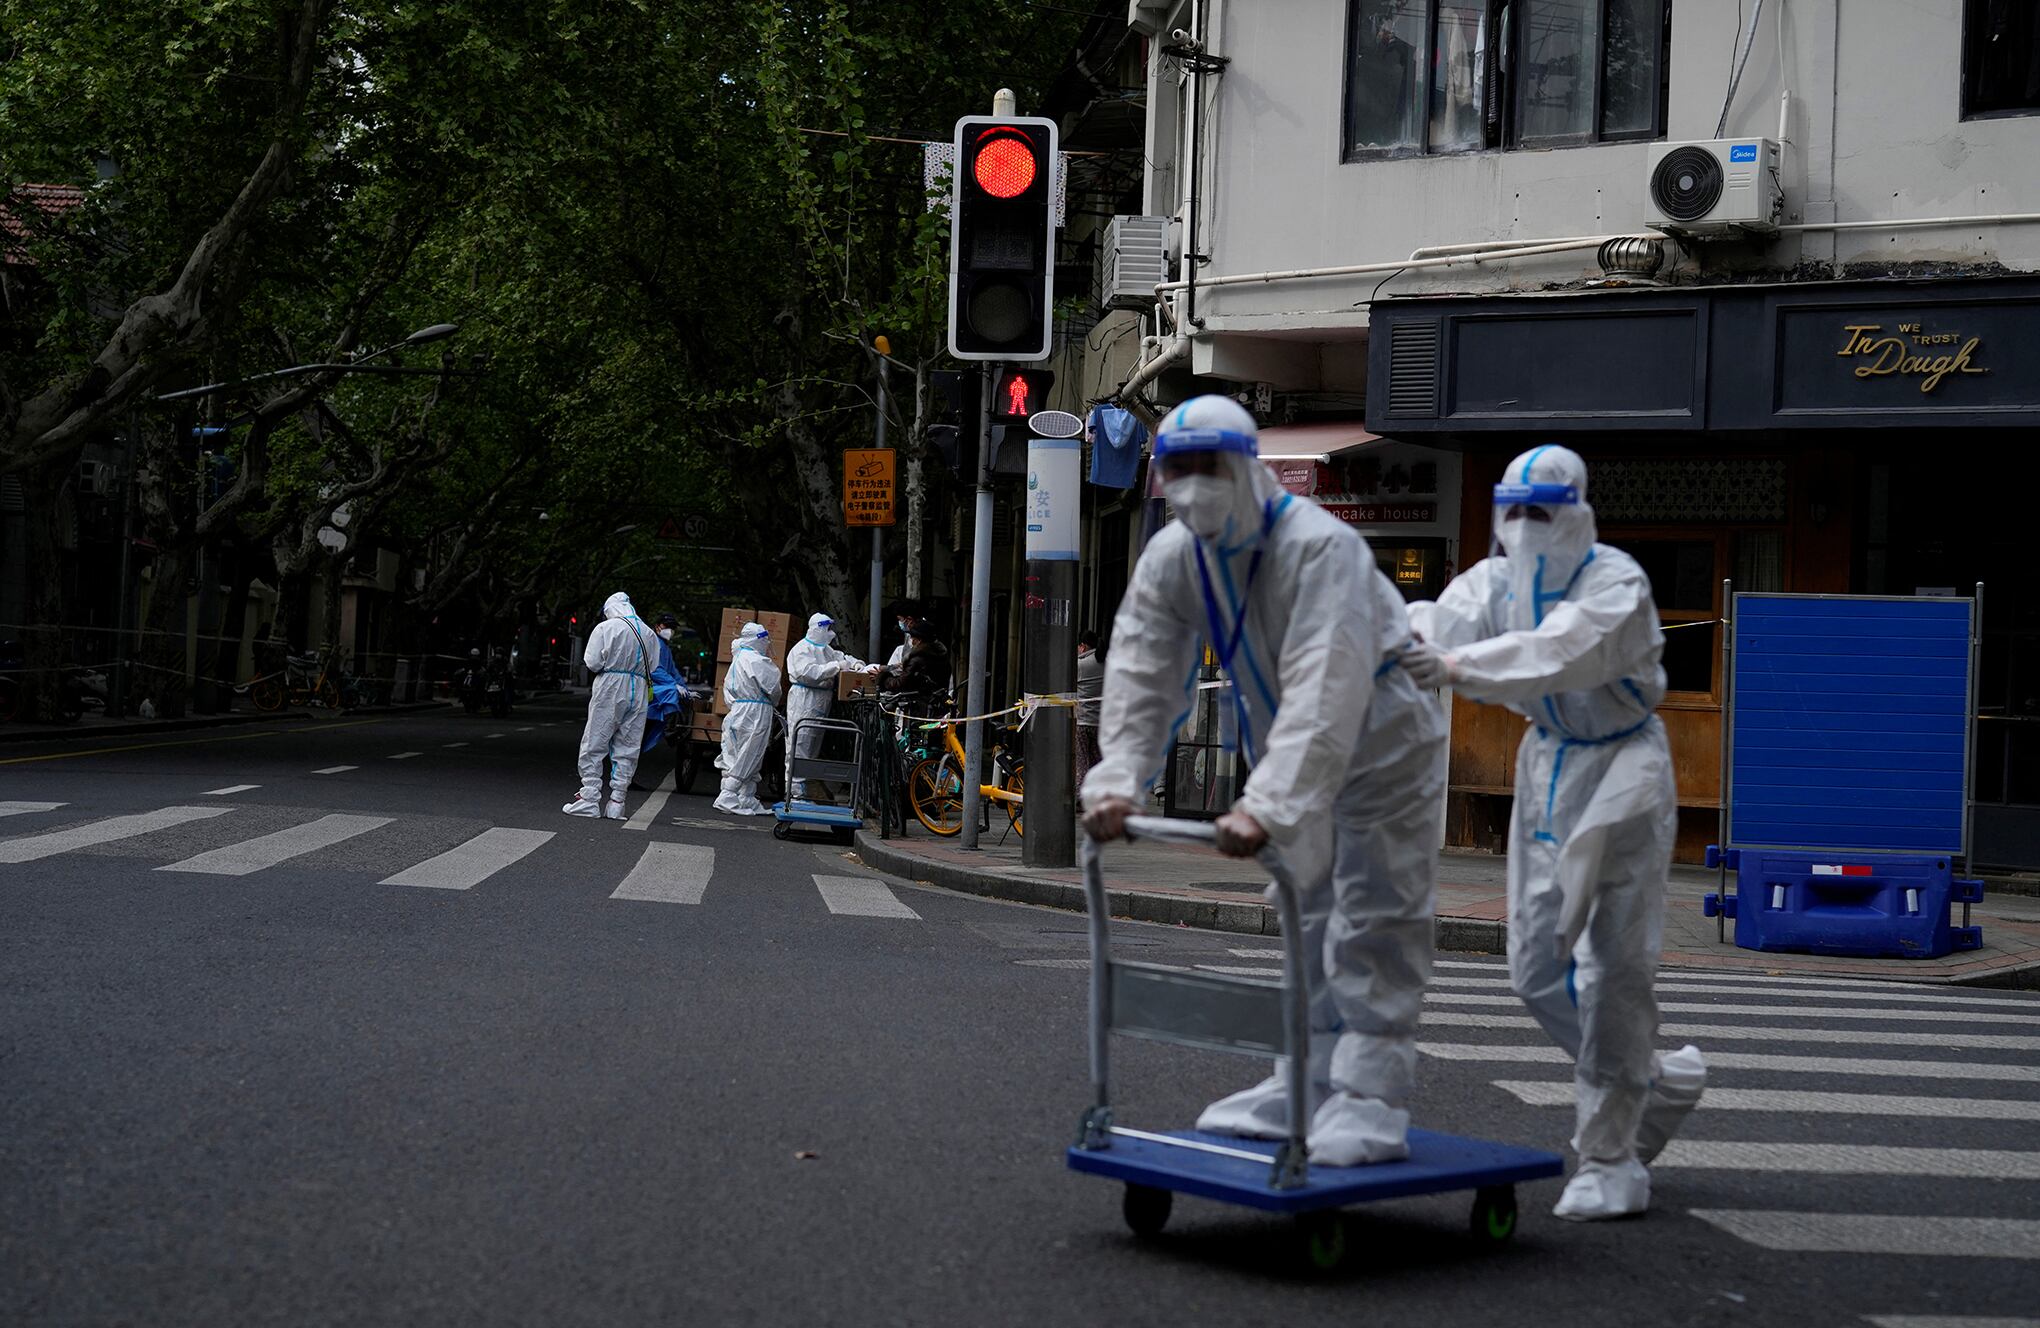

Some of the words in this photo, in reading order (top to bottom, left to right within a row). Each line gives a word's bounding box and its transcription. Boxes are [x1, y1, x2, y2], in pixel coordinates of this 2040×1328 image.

[1898, 323, 1921, 333] WE
[1837, 325, 1881, 355] In
[1912, 334, 1960, 345] TRUST
[848, 479, 891, 488] 停车行为违法
[1329, 505, 1375, 520] ncake
[1383, 504, 1429, 520] house
